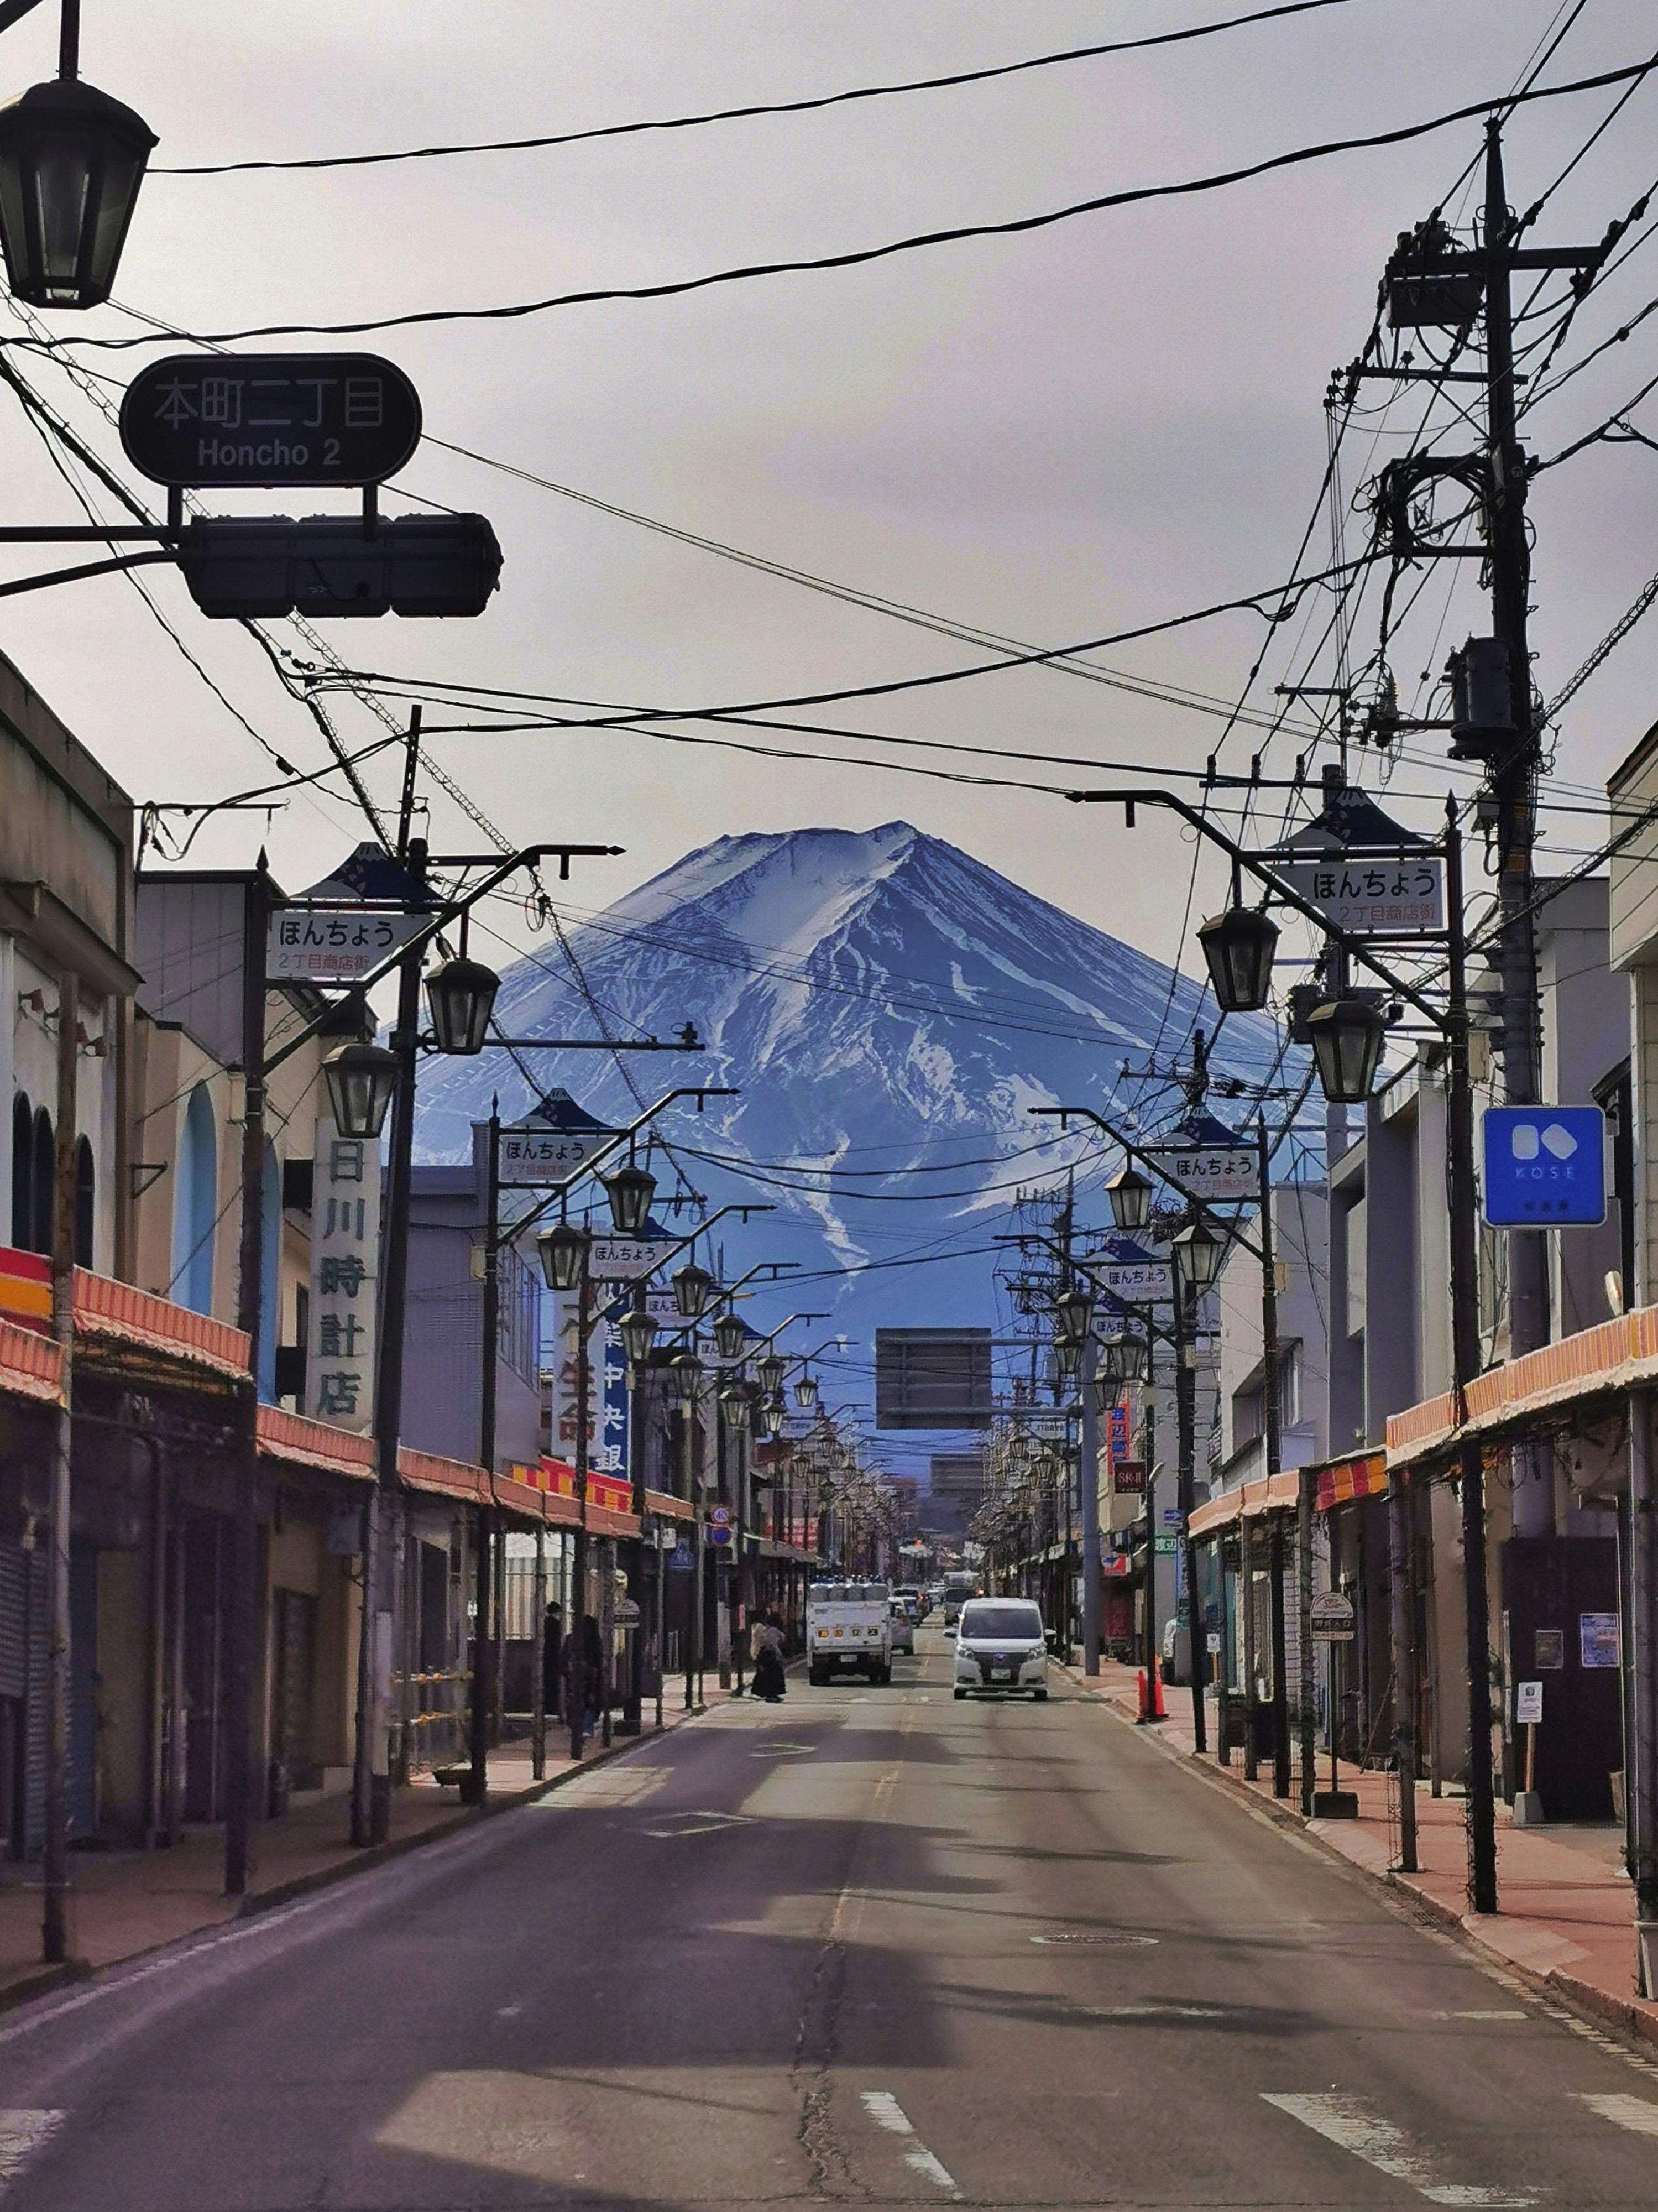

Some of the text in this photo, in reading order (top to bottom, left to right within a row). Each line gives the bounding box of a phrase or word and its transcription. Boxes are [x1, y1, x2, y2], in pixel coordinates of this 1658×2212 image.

[154, 377, 383, 430] 本町二丁目
[198, 439, 341, 466] Honcho 2
[1314, 868, 1435, 899] ほんちょう
[280, 920, 394, 947] ほんちょう
[506, 1141, 585, 1161] ほんちょう
[1177, 1156, 1252, 1176] ほんちょう
[594, 1246, 657, 1261] ほんちょう
[317, 1140, 366, 1416] 日川時計店
[1109, 1268, 1167, 1285] ほんちょう
